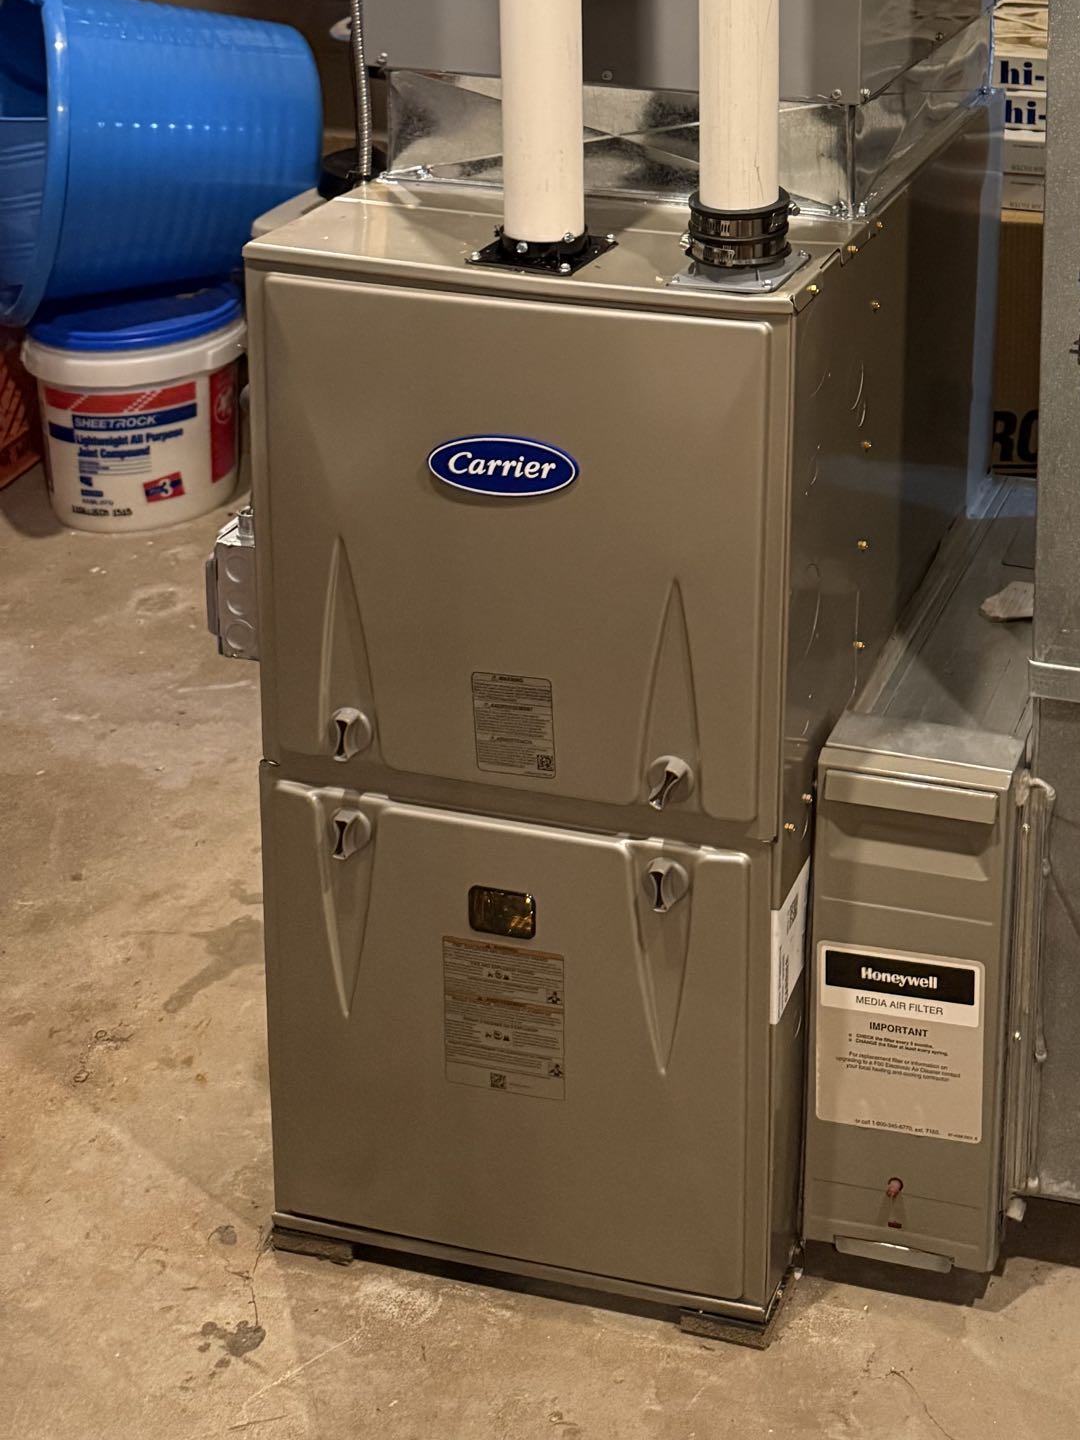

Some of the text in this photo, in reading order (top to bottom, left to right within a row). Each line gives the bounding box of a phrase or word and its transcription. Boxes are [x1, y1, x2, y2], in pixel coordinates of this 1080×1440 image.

[74, 415, 157, 429] SHEETROCK
[448, 451, 556, 479] Carrier
[160, 478, 173, 497] 3
[861, 966, 938, 989] Honeywell
[855, 995, 944, 1015] MEDIA AIR FILTER
[869, 1022, 928, 1038] IMPORTANT
[858, 1052, 891, 1061] replacement
